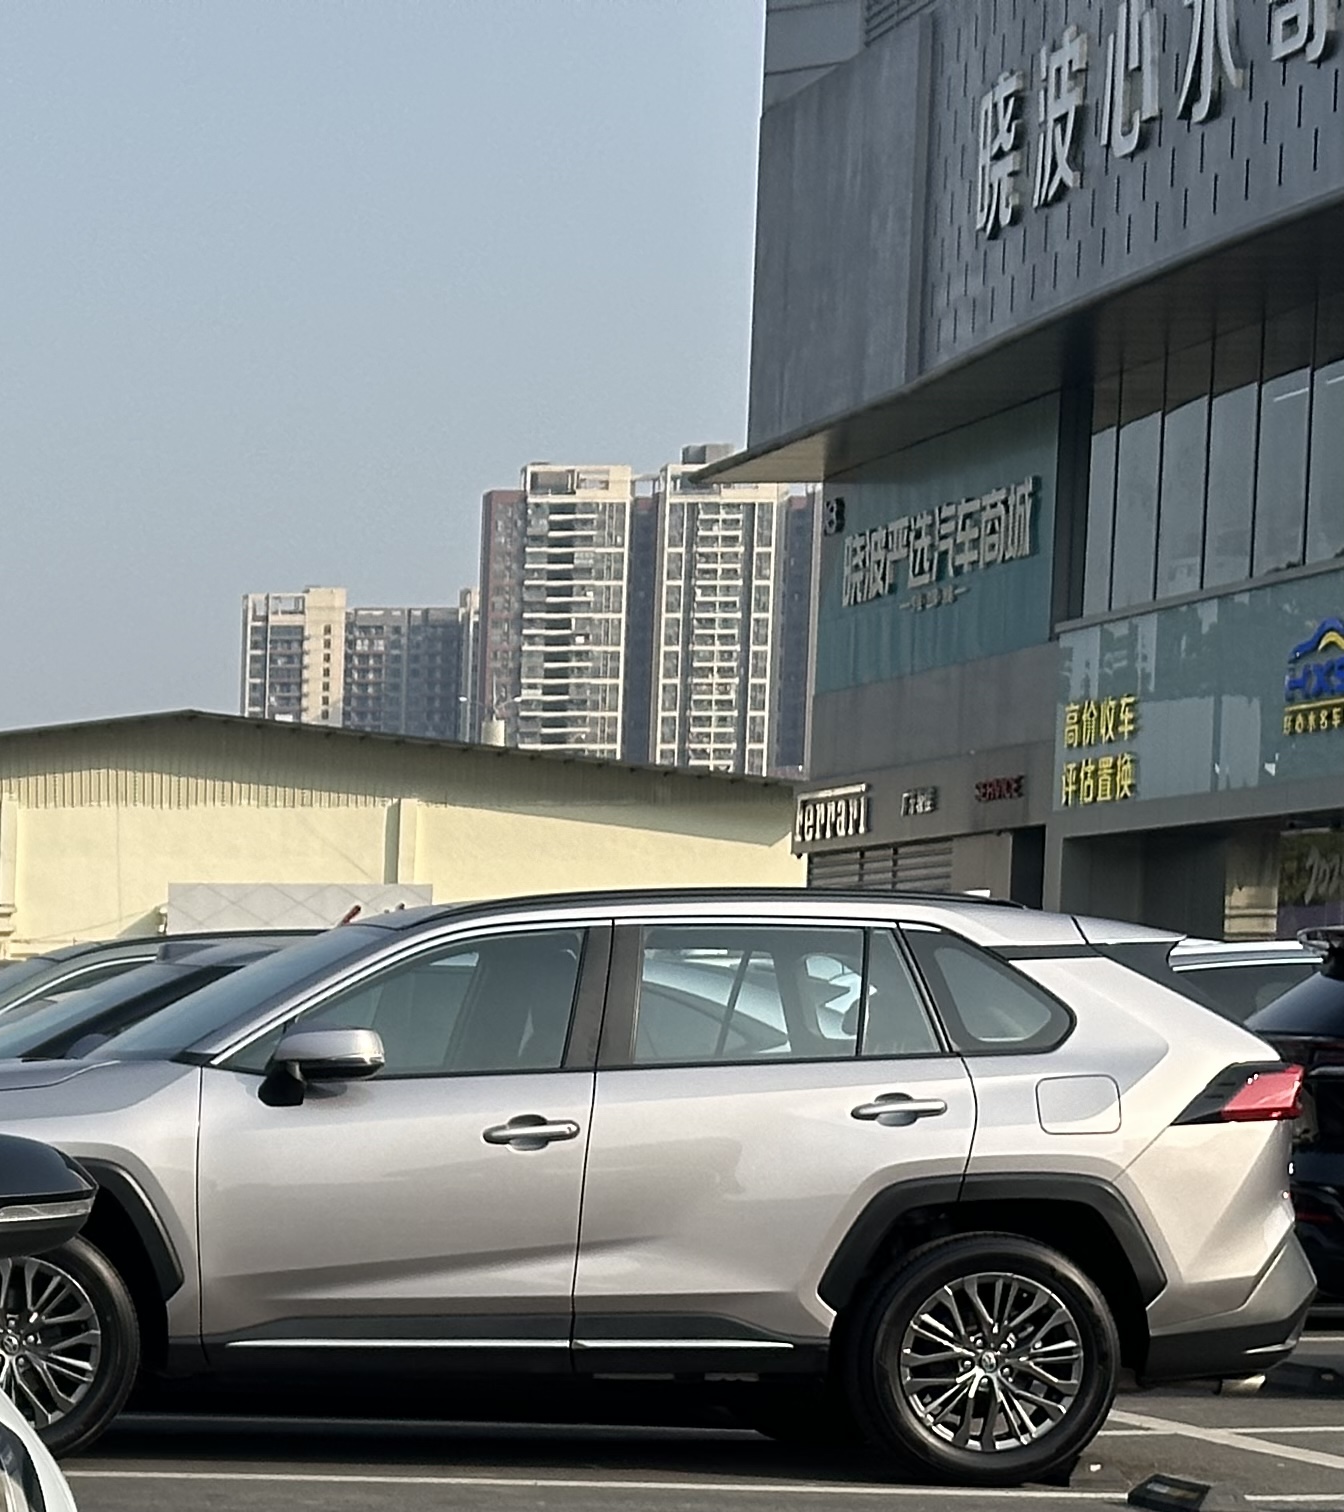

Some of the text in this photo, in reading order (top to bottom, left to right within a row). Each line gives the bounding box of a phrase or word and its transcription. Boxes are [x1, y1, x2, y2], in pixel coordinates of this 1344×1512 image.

[1063, 694, 1136, 748] 高价收车
[1060, 753, 1135, 807] 评估置换
[794, 783, 868, 842] Ferrari
